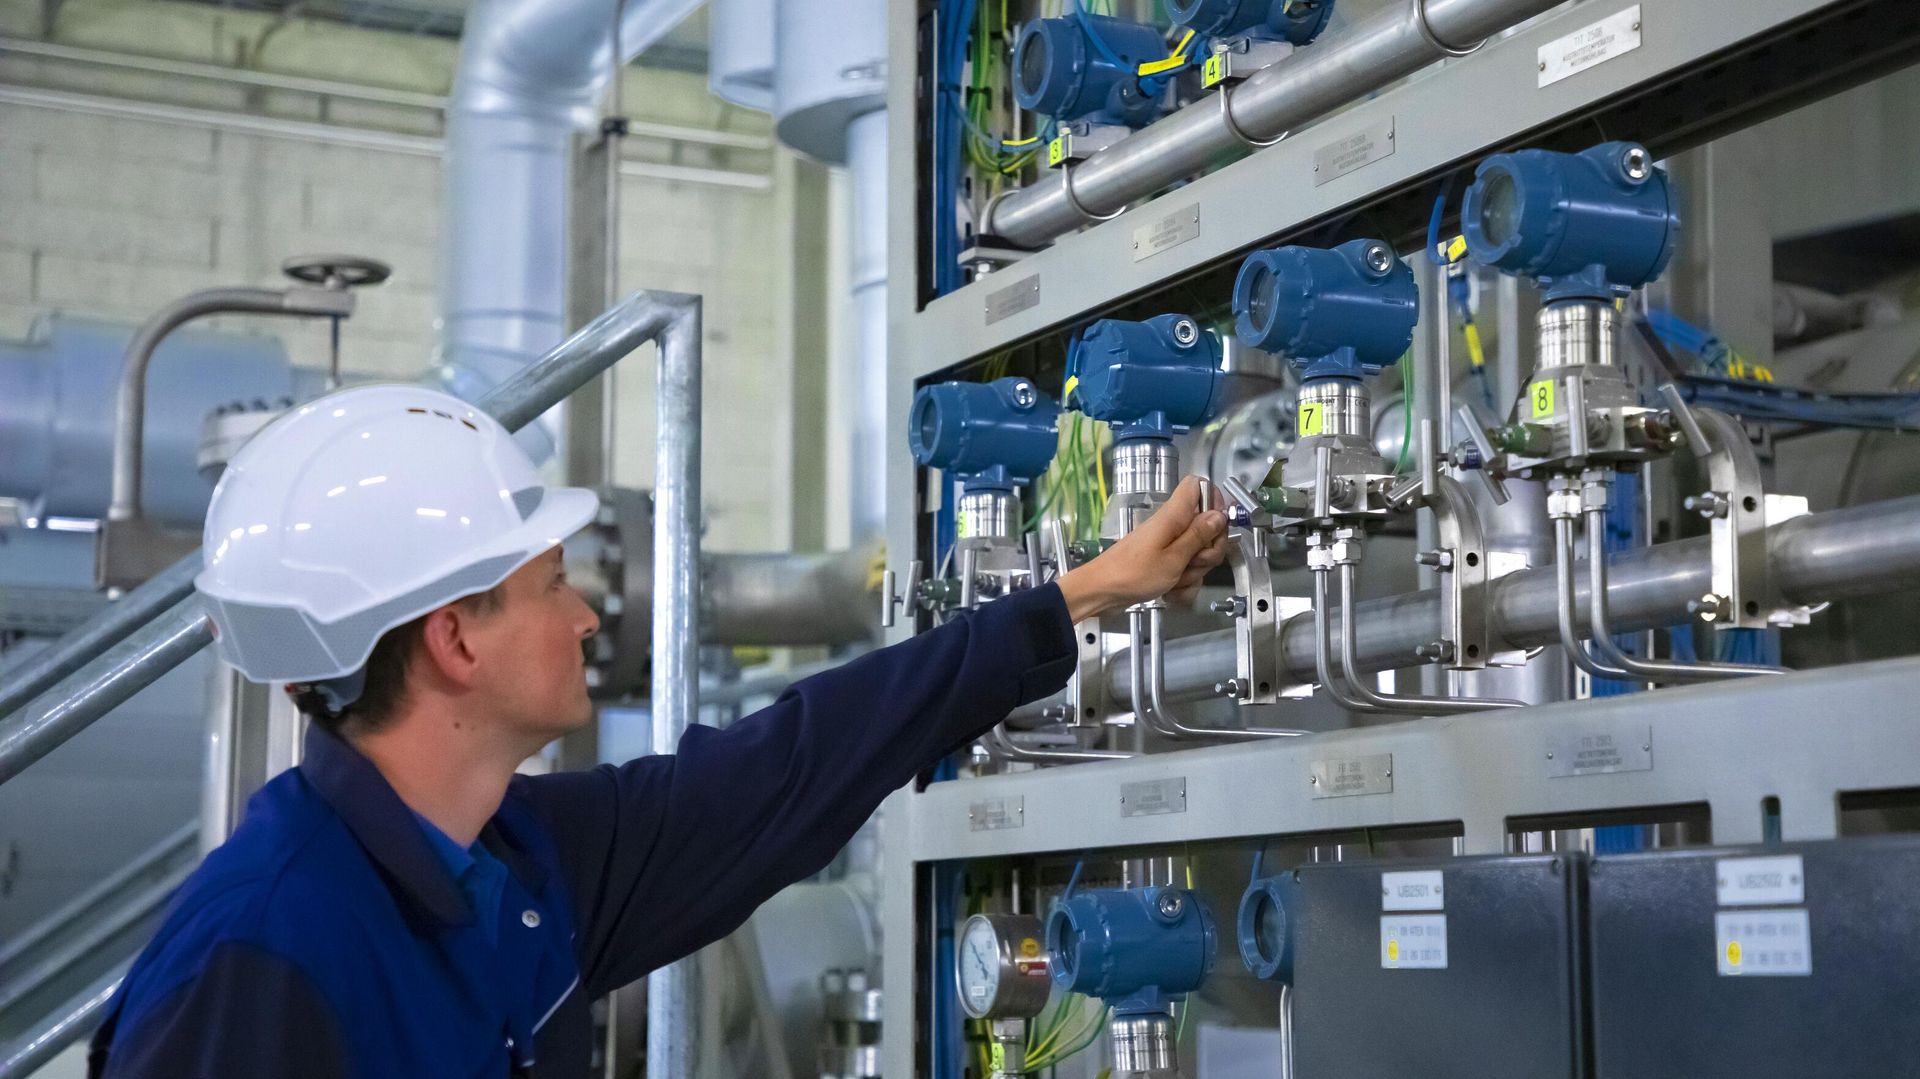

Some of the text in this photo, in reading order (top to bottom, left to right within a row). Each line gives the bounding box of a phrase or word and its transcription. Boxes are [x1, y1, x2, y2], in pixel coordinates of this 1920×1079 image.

[1208, 60, 1216, 79] 4
[1538, 386, 1548, 411] 8
[1303, 408, 1314, 430] 7
